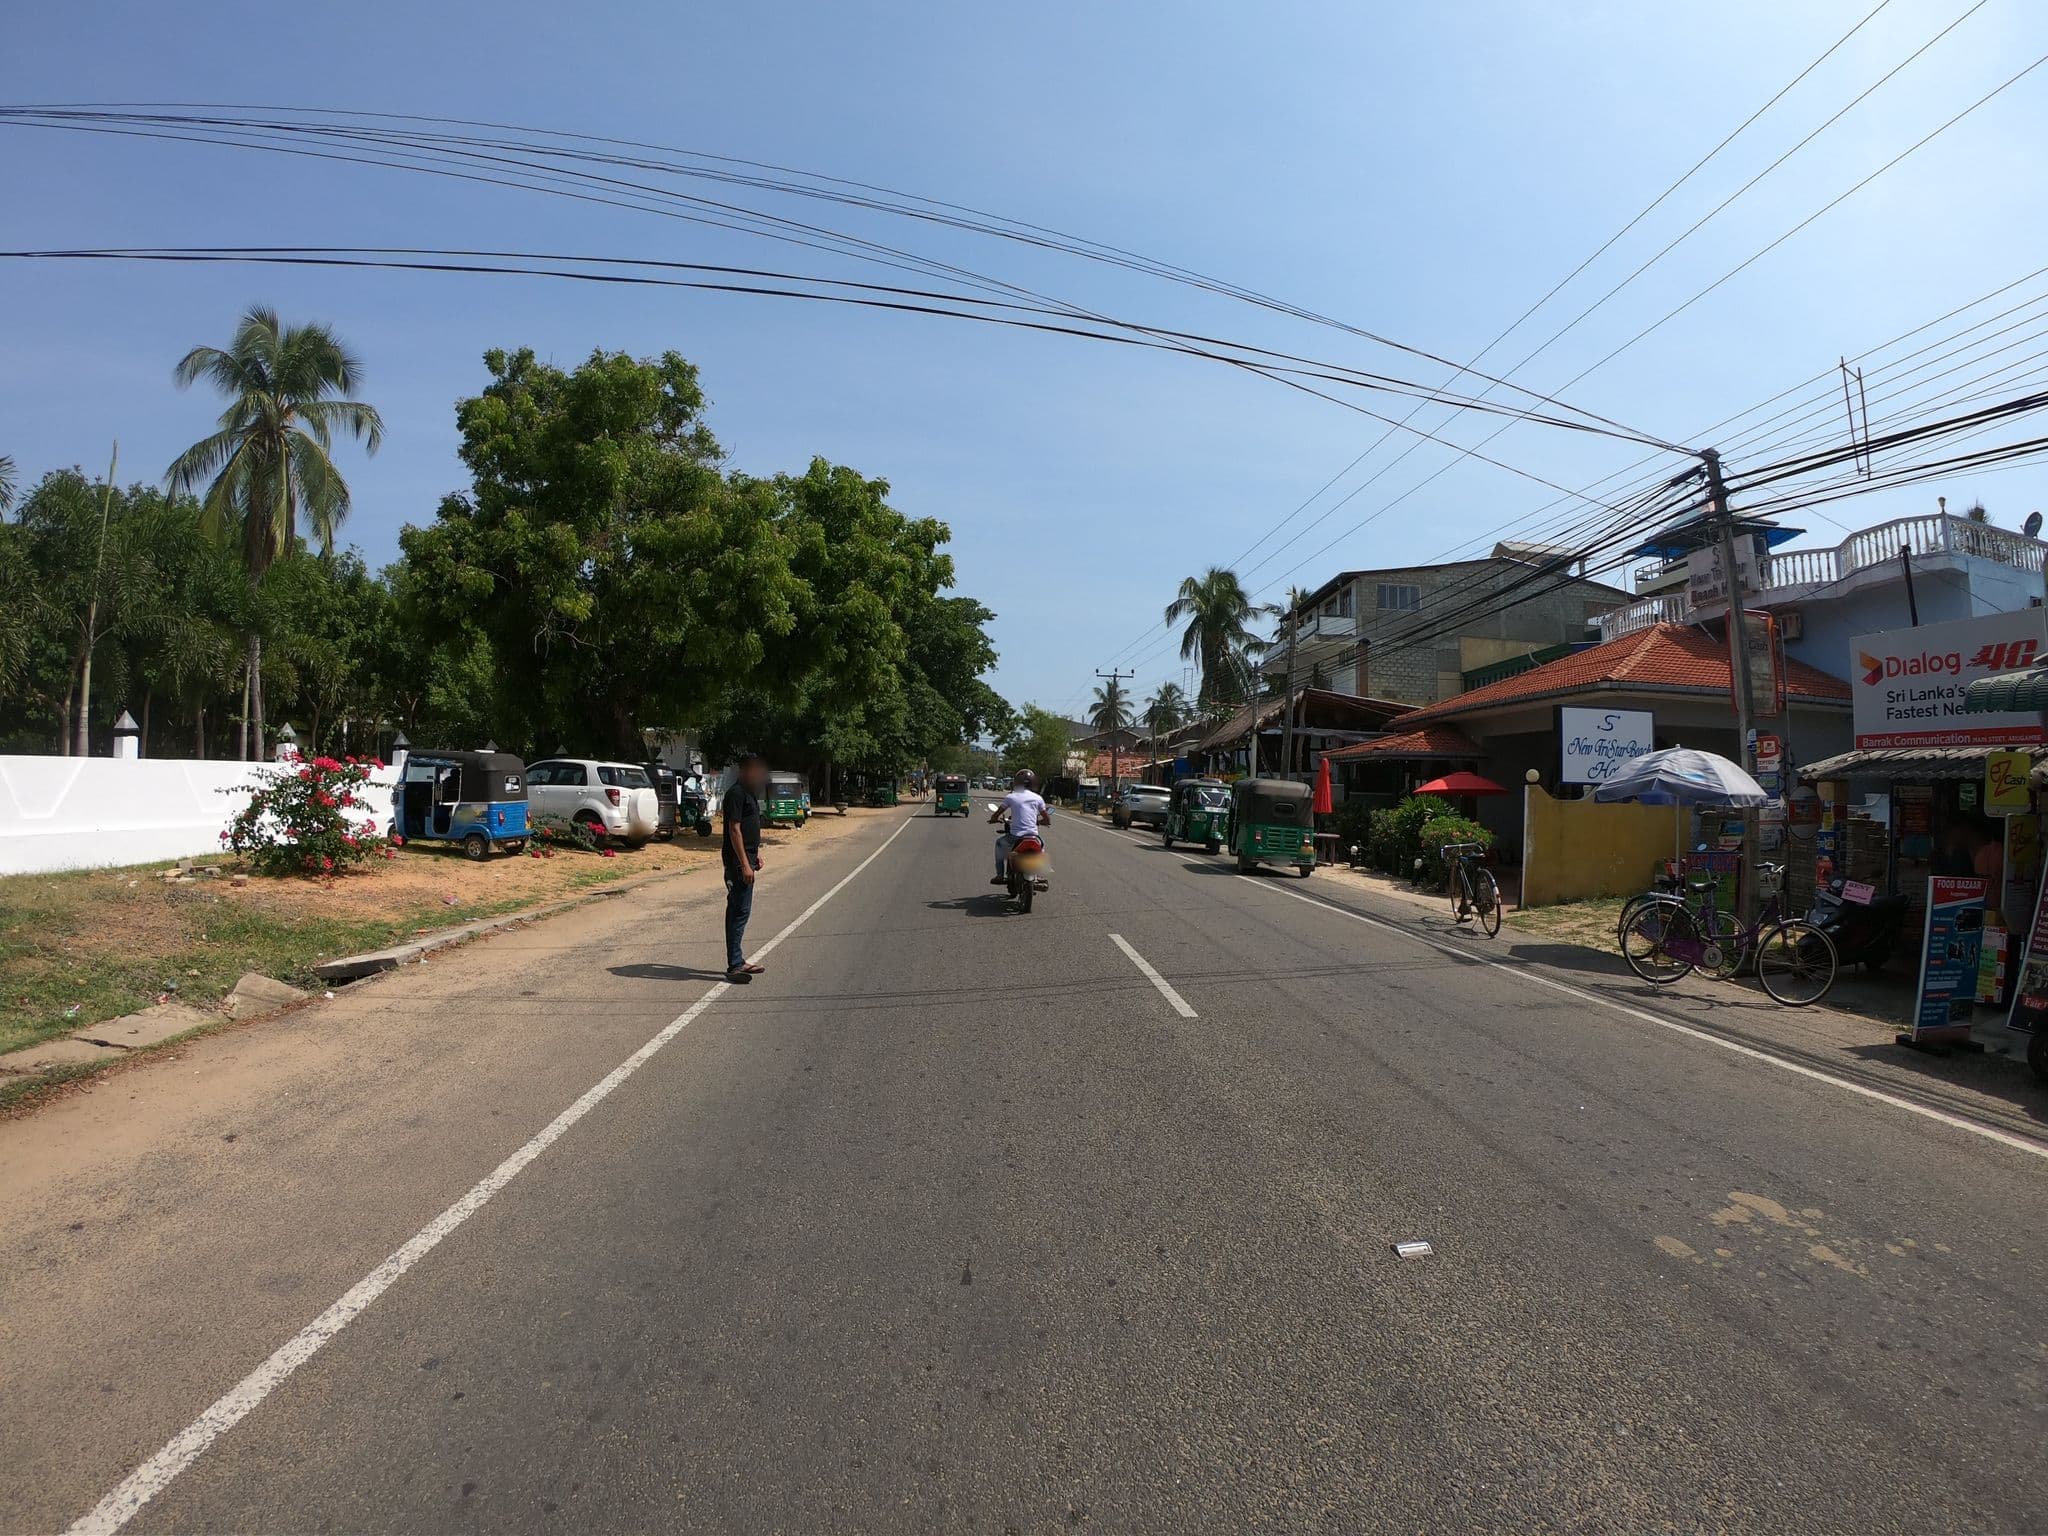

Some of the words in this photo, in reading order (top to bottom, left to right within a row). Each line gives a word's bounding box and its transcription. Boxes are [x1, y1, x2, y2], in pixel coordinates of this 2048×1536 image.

[1885, 651, 1962, 679] Dialog
[1966, 638, 2039, 671] 4G
[1887, 689, 1905, 703] Sri
[1910, 684, 1966, 701] Lanka's
[1886, 705, 1938, 720] Fastest
[1567, 737, 1594, 755] New
[1862, 735, 1891, 748] Barrak
[1894, 731, 1971, 747] Communication
[2004, 774, 2026, 785] Cash
[1937, 879, 1955, 889] FOOD
[1956, 880, 1982, 890] BAZAAR
